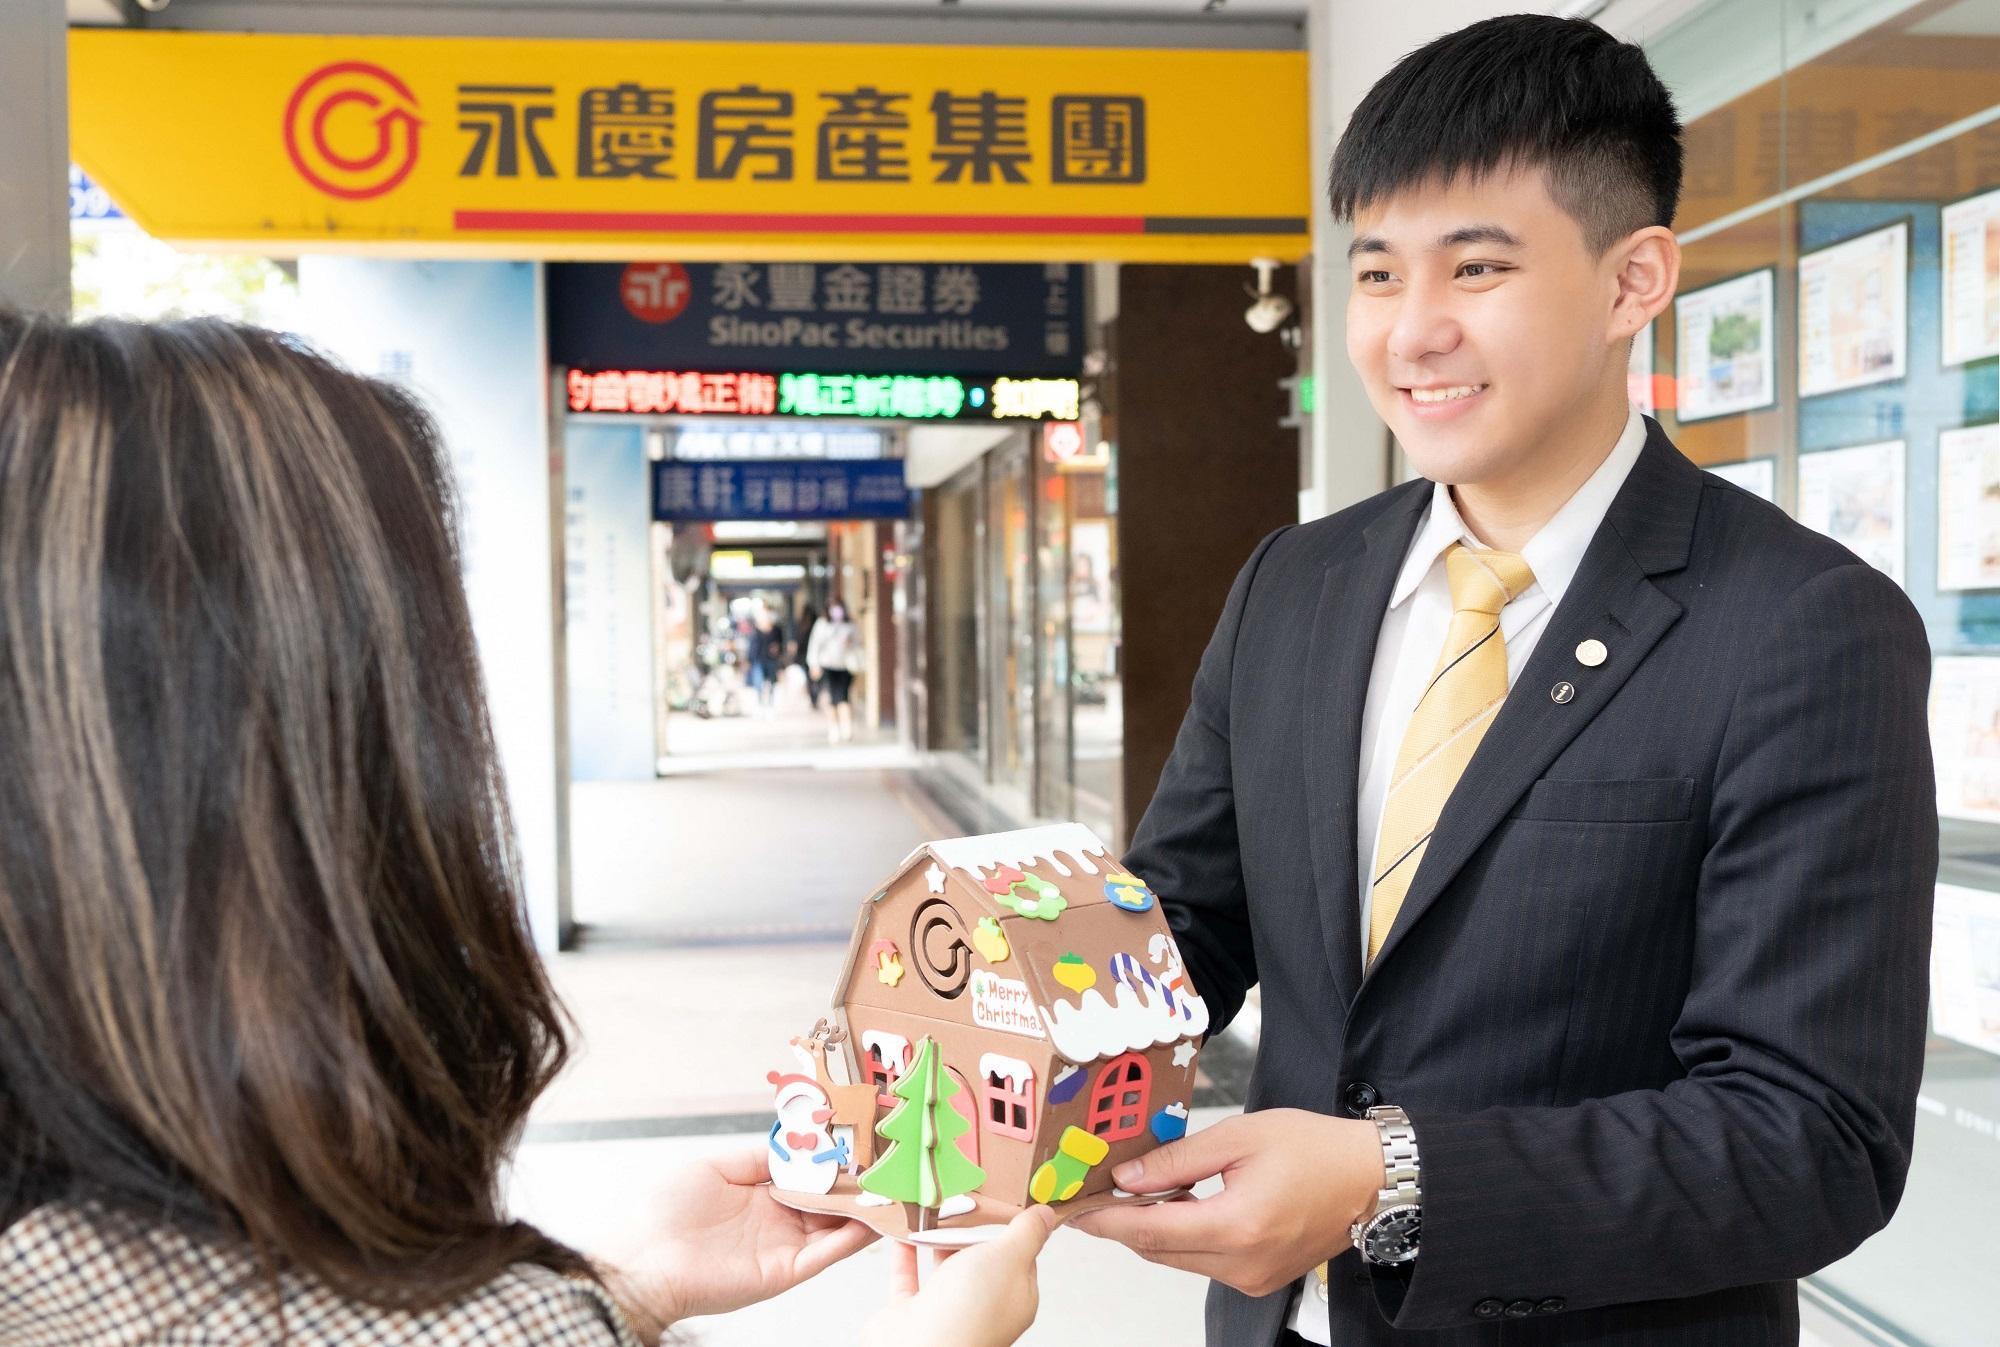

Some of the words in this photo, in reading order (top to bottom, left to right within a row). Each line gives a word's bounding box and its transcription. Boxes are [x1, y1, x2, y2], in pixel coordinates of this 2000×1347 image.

[458, 82, 1147, 185] 永慶房產集團
[708, 314, 839, 347] SinoPac
[845, 318, 1008, 349] Securities
[988, 979, 1029, 1004] Merry
